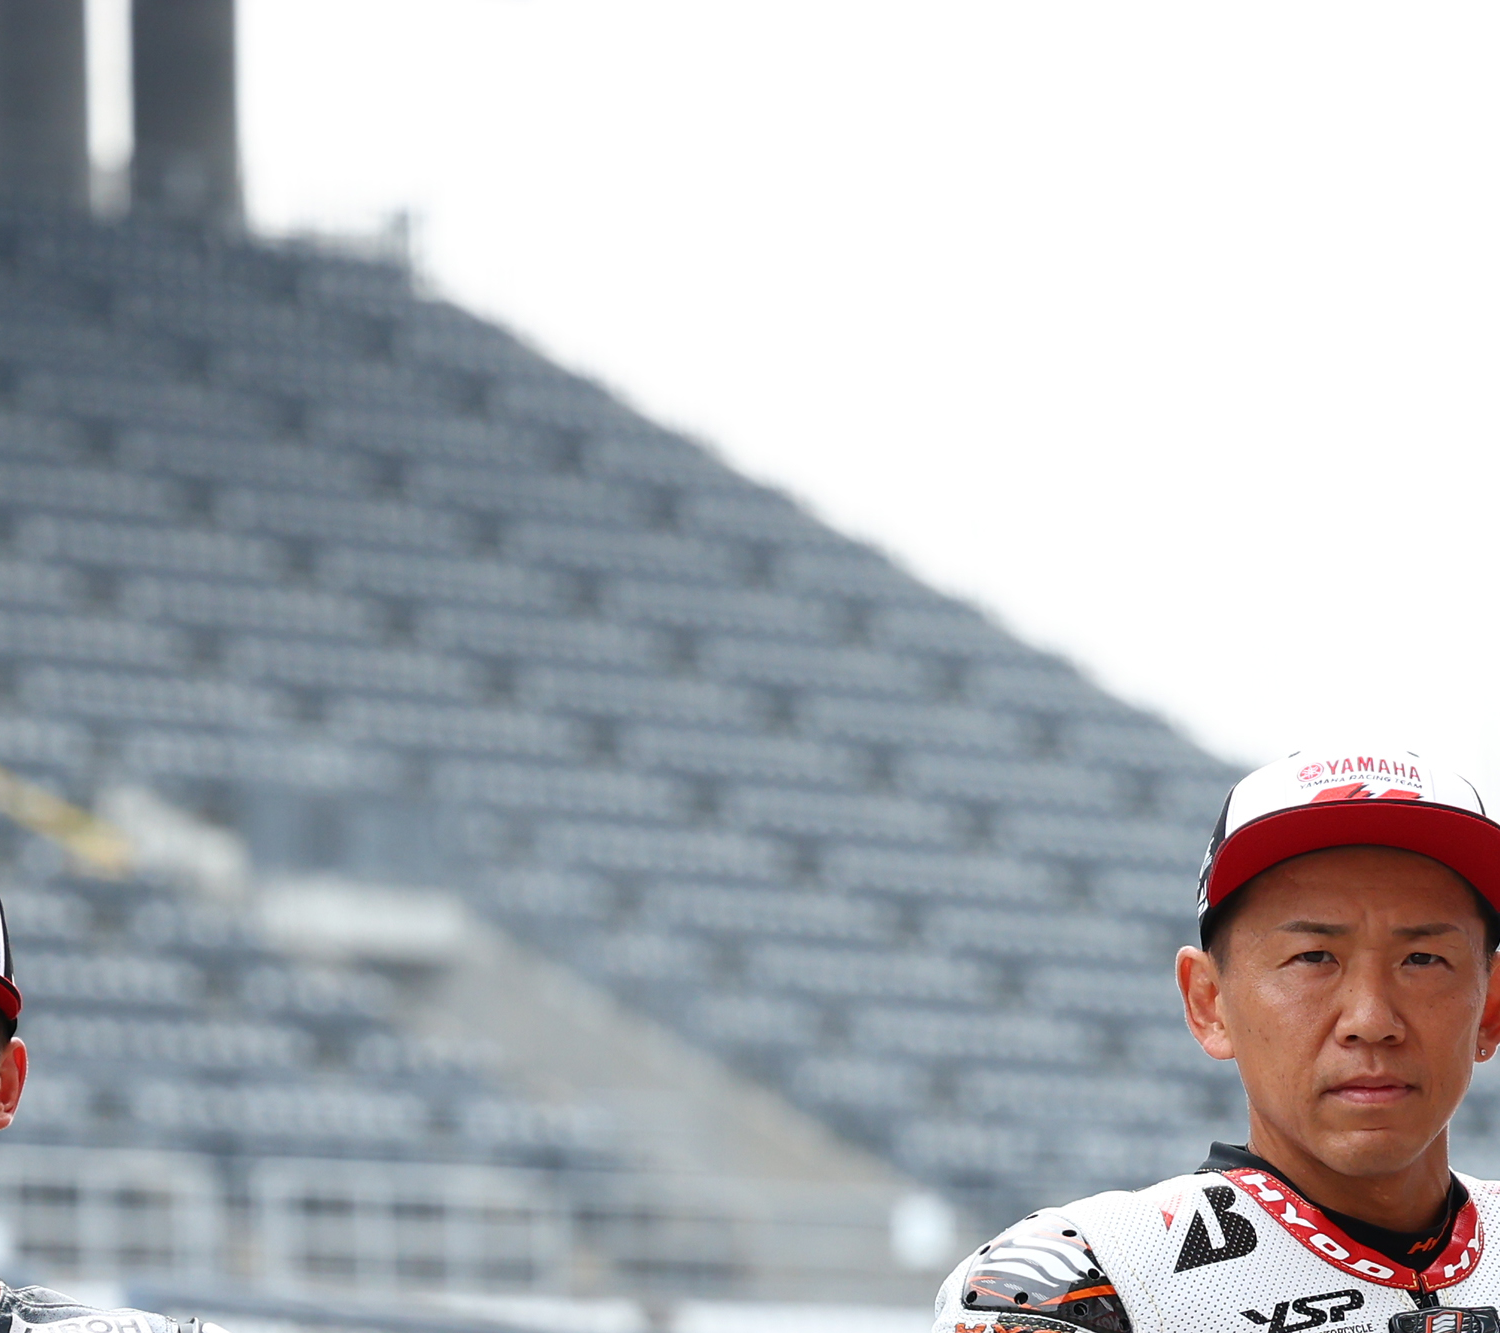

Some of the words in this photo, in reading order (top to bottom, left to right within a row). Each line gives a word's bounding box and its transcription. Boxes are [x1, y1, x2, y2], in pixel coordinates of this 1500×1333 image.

[1300, 776, 1346, 790] YAMAHA
[1349, 774, 1392, 785] RACING
[1394, 777, 1423, 789] TEAM
[1326, 756, 1421, 782] YAMAHA
[1240, 1172, 1396, 1280] HYOD
